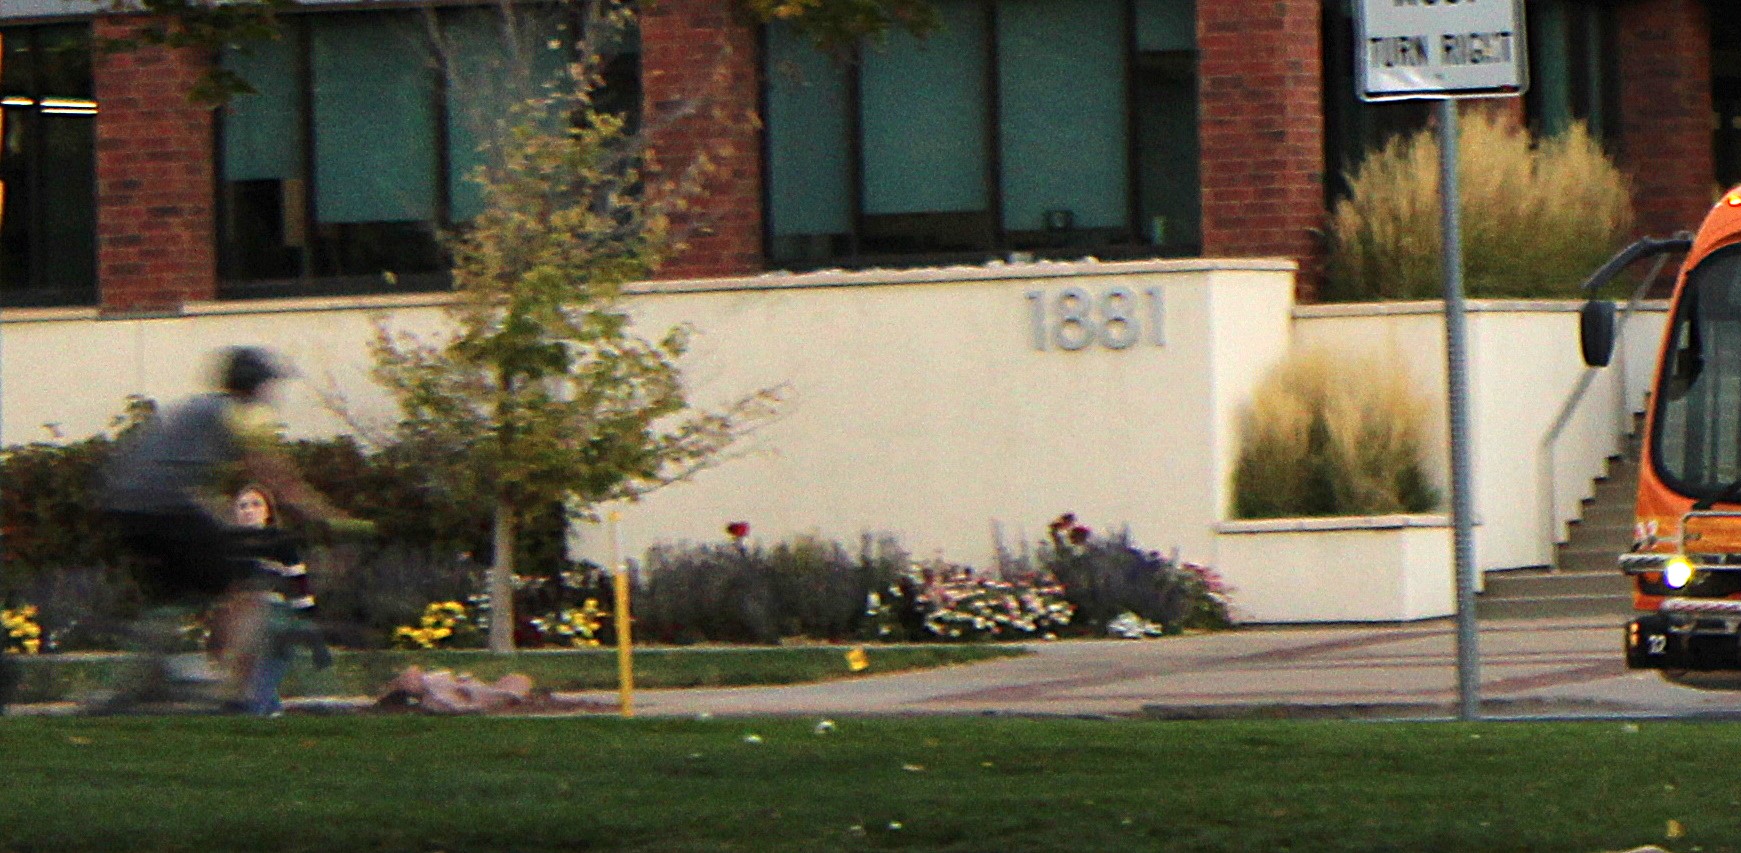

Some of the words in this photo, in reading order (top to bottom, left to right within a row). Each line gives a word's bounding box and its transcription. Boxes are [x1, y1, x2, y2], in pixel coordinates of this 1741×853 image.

[1368, 36, 1428, 68] TURN
[1441, 31, 1512, 65] RIGHT
[1024, 286, 1167, 351] 1881
